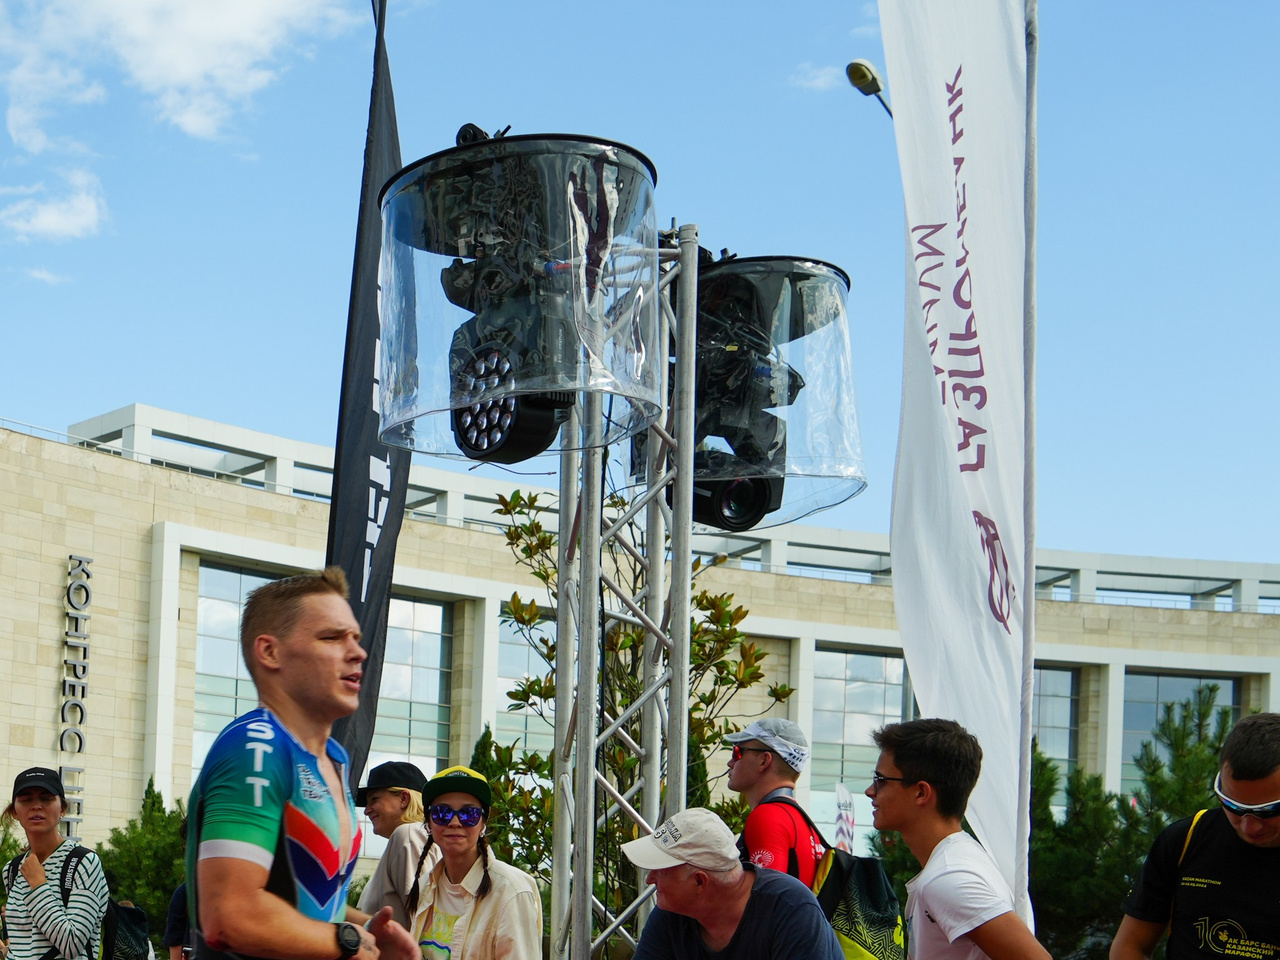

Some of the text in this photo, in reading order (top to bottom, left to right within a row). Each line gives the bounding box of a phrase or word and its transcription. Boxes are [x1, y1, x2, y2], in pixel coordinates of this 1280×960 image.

[60, 554, 94, 753] КОНГРЕСС
[65, 857, 79, 889] IRONSTAR
[1226, 943, 1274, 956] КАЗАНСКИЙ
[1240, 939, 1260, 947] БАРС
[1224, 949, 1263, 960] МАРАФОН
